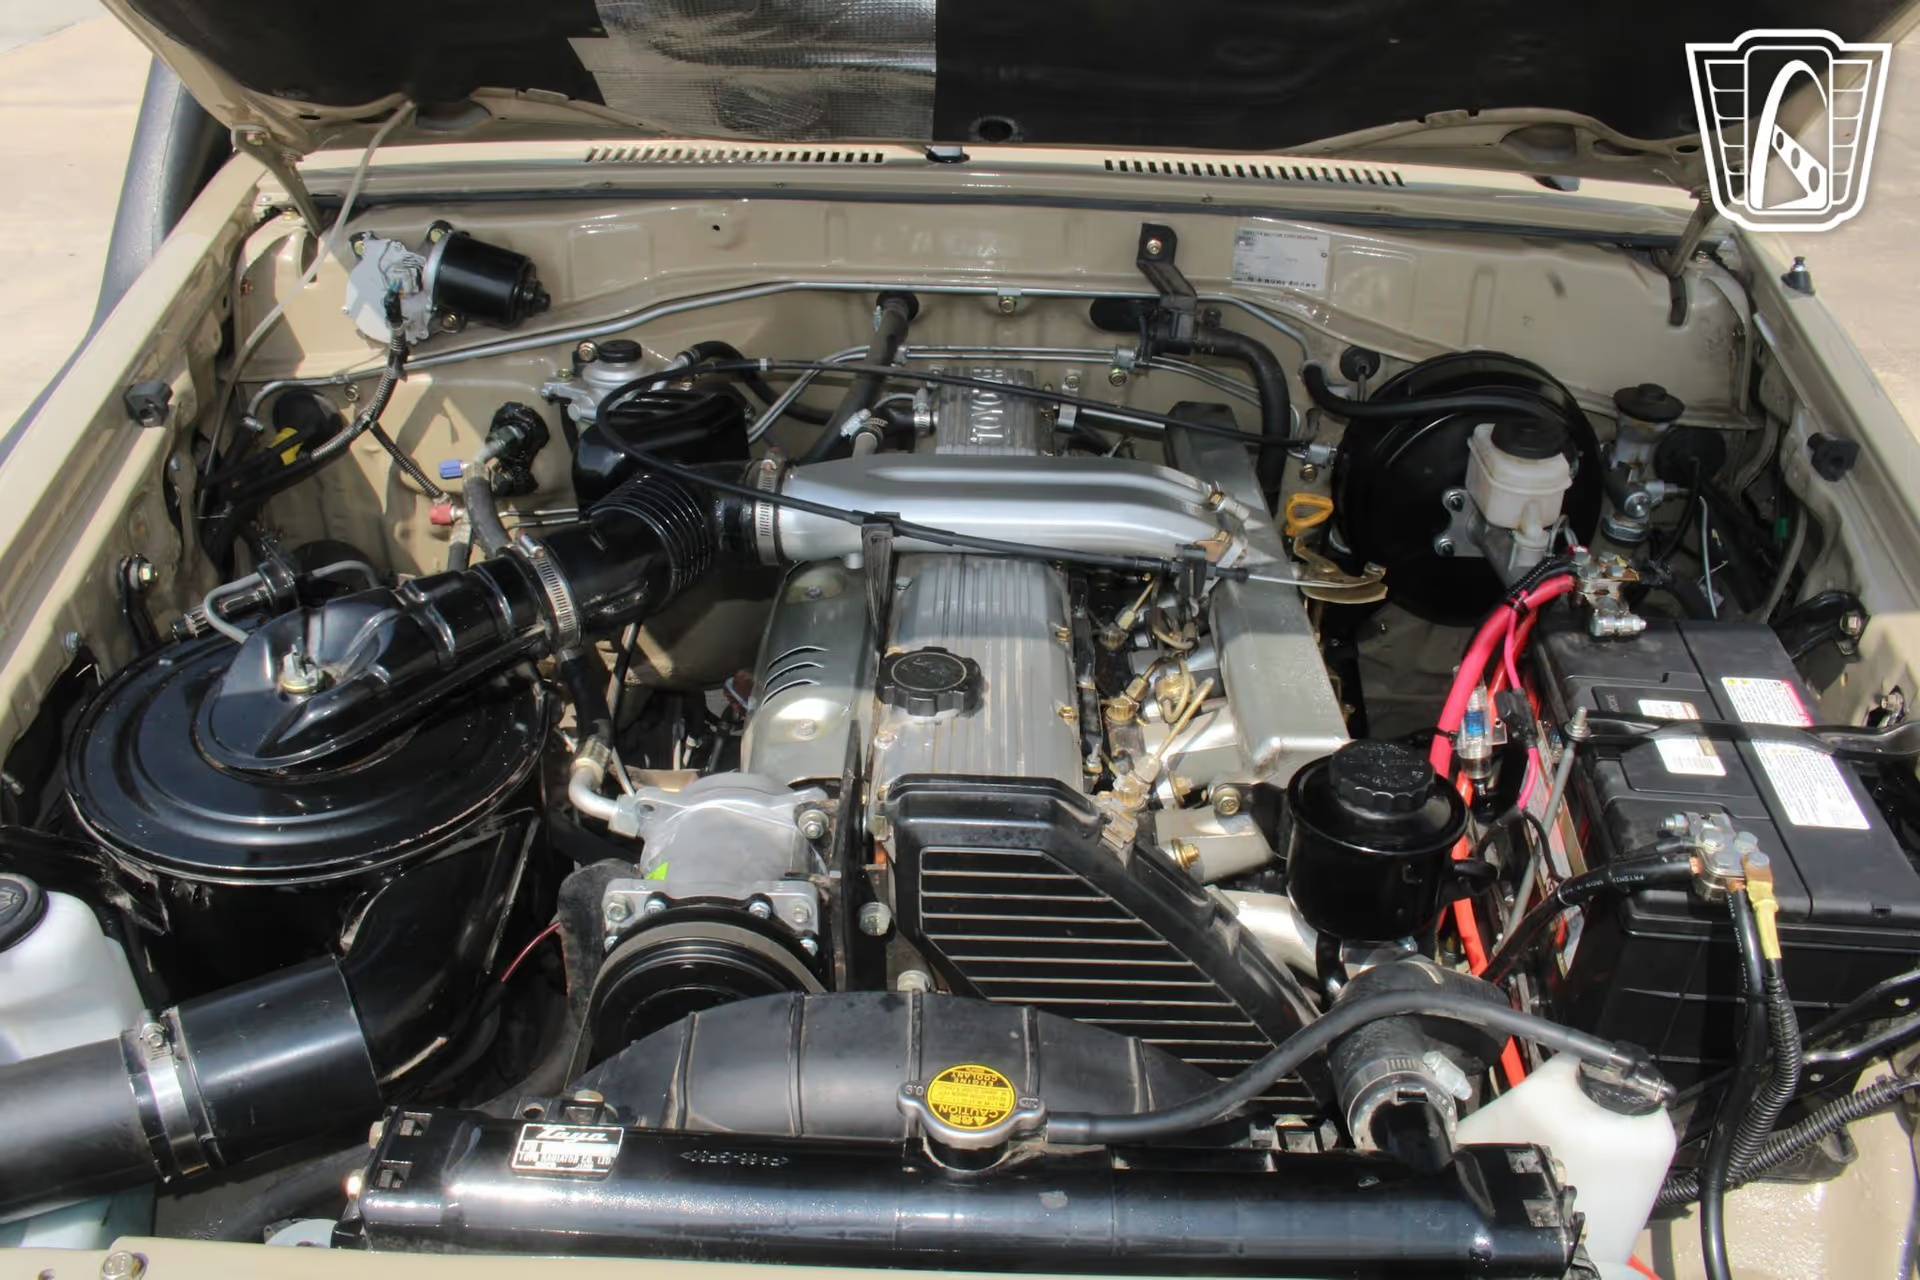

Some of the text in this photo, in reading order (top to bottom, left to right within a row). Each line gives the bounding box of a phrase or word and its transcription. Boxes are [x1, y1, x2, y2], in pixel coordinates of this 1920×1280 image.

[970, 371, 1003, 443] TOYOA
[950, 1071, 998, 1082] COOLANT
[952, 1076, 994, 1087] ENGINE
[938, 1104, 999, 1118] CAUTION
